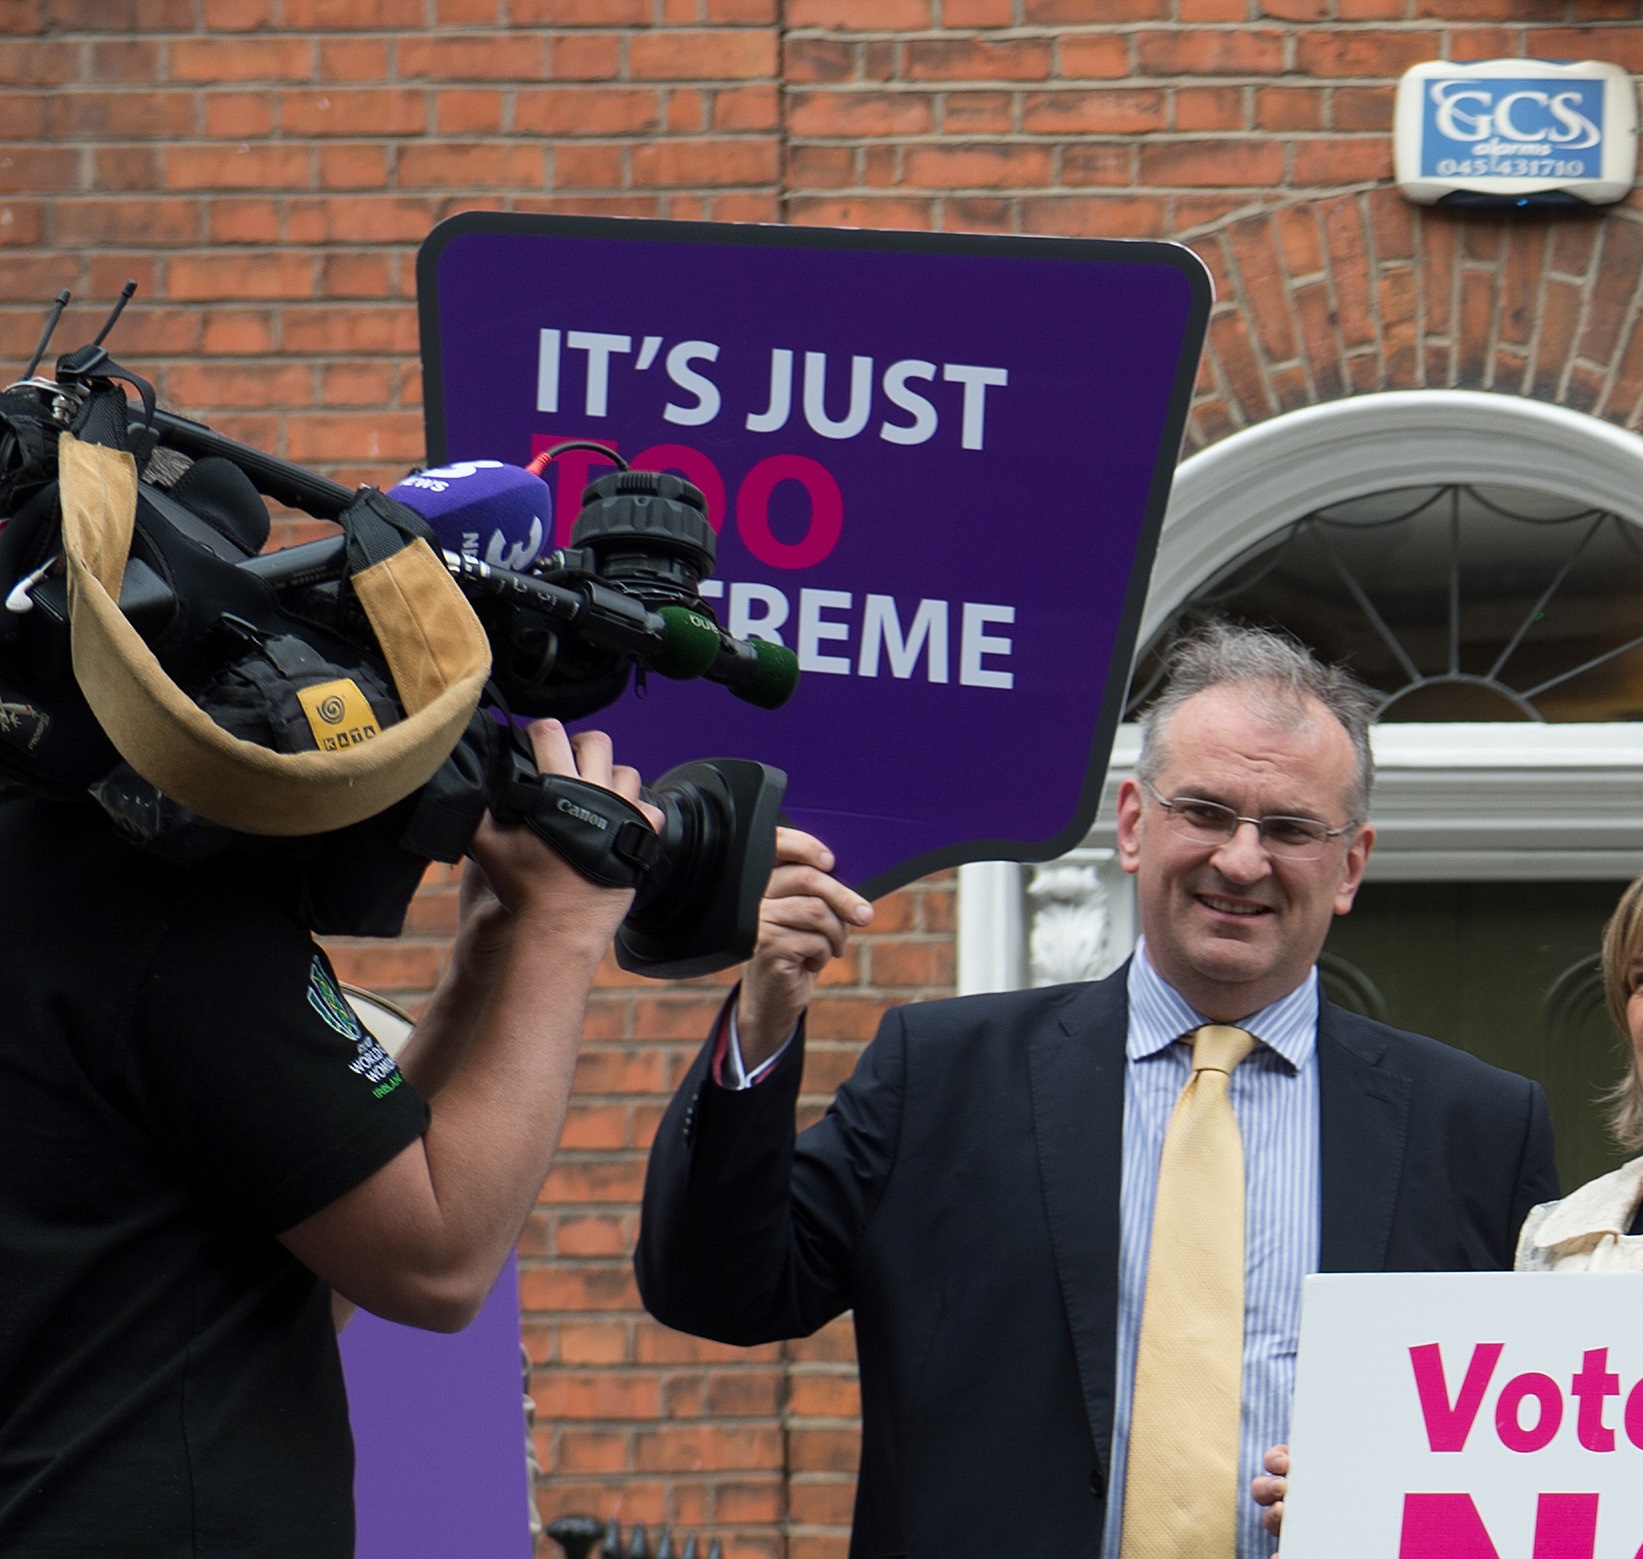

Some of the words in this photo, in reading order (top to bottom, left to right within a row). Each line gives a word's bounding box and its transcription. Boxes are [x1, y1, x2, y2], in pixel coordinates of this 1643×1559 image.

[1432, 82, 1600, 148] GCS
[536, 328, 721, 427] IT'S
[746, 349, 1008, 451] JUST
[323, 725, 376, 751] KATA
[557, 798, 608, 830] Canon
